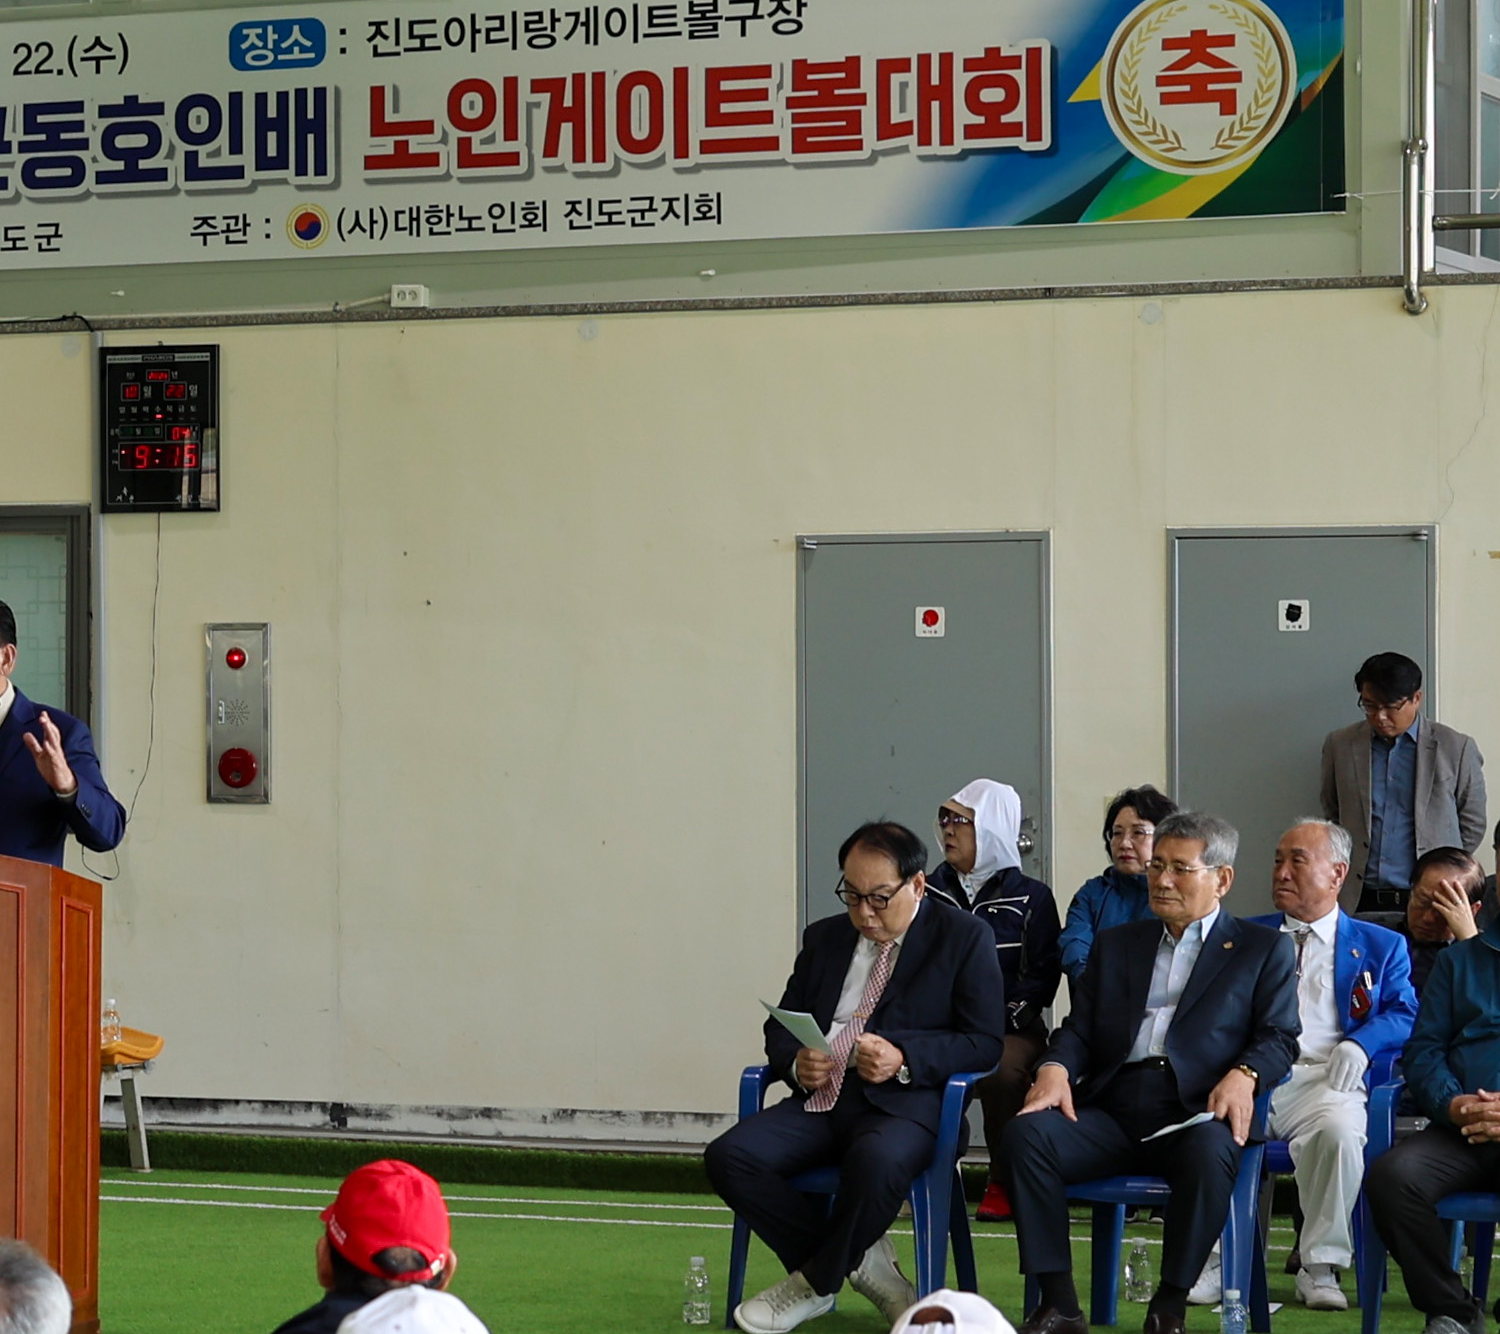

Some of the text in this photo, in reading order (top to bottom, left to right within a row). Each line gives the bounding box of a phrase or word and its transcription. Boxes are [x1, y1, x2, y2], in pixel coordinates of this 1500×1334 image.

[240, 24, 316, 66] 장소
[1155, 28, 1243, 117] 축
[364, 45, 1043, 171] 노인게이트볼대회
[190, 213, 251, 246] 주관
[563, 192, 723, 230] 진도군지회
